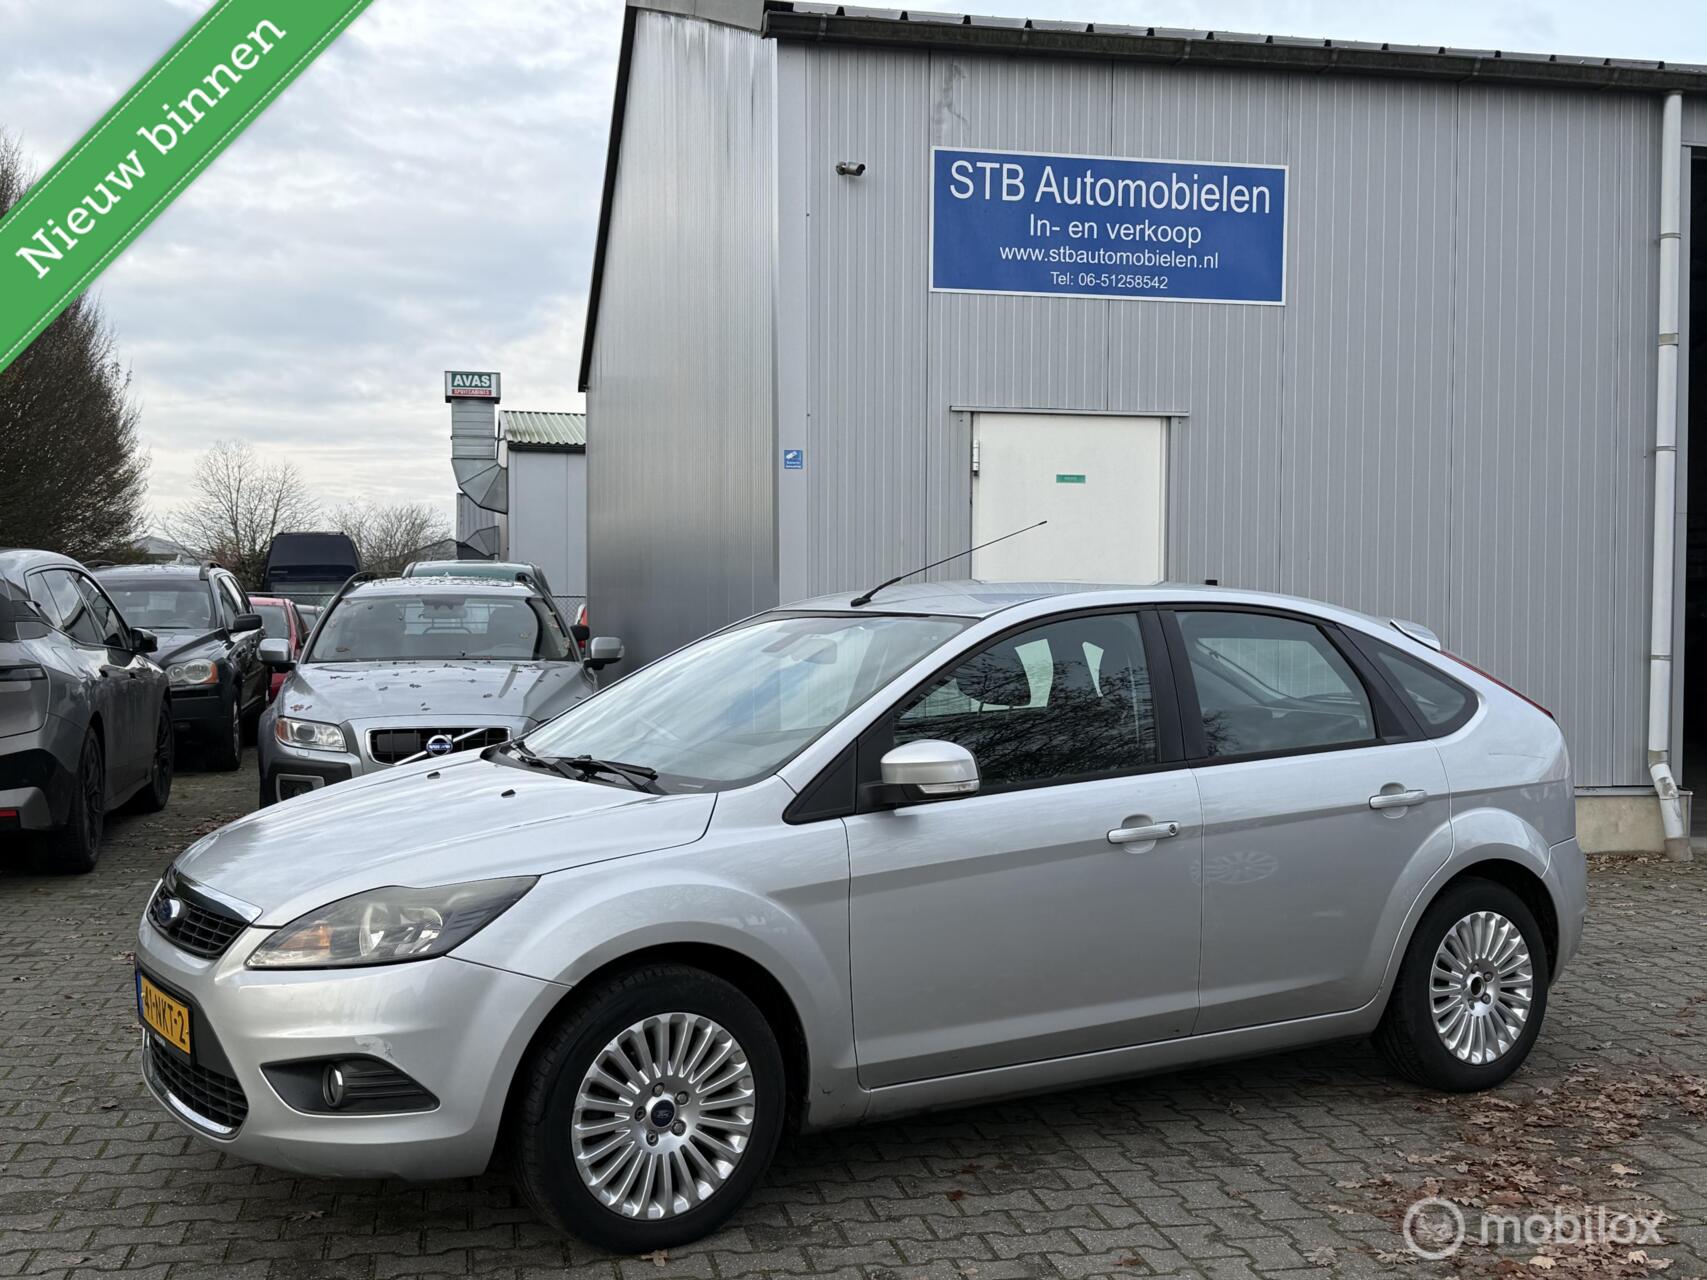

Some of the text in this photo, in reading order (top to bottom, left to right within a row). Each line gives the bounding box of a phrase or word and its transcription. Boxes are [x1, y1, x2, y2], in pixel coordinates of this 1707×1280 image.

[949, 160, 1271, 213] STB Automobielen
[1029, 213, 1202, 249] In- en verkoop
[999, 245, 1219, 269] www.stbautomobielen.nl
[1050, 271, 1169, 289] Tel: 06-51258542
[453, 374, 490, 387] AVAS
